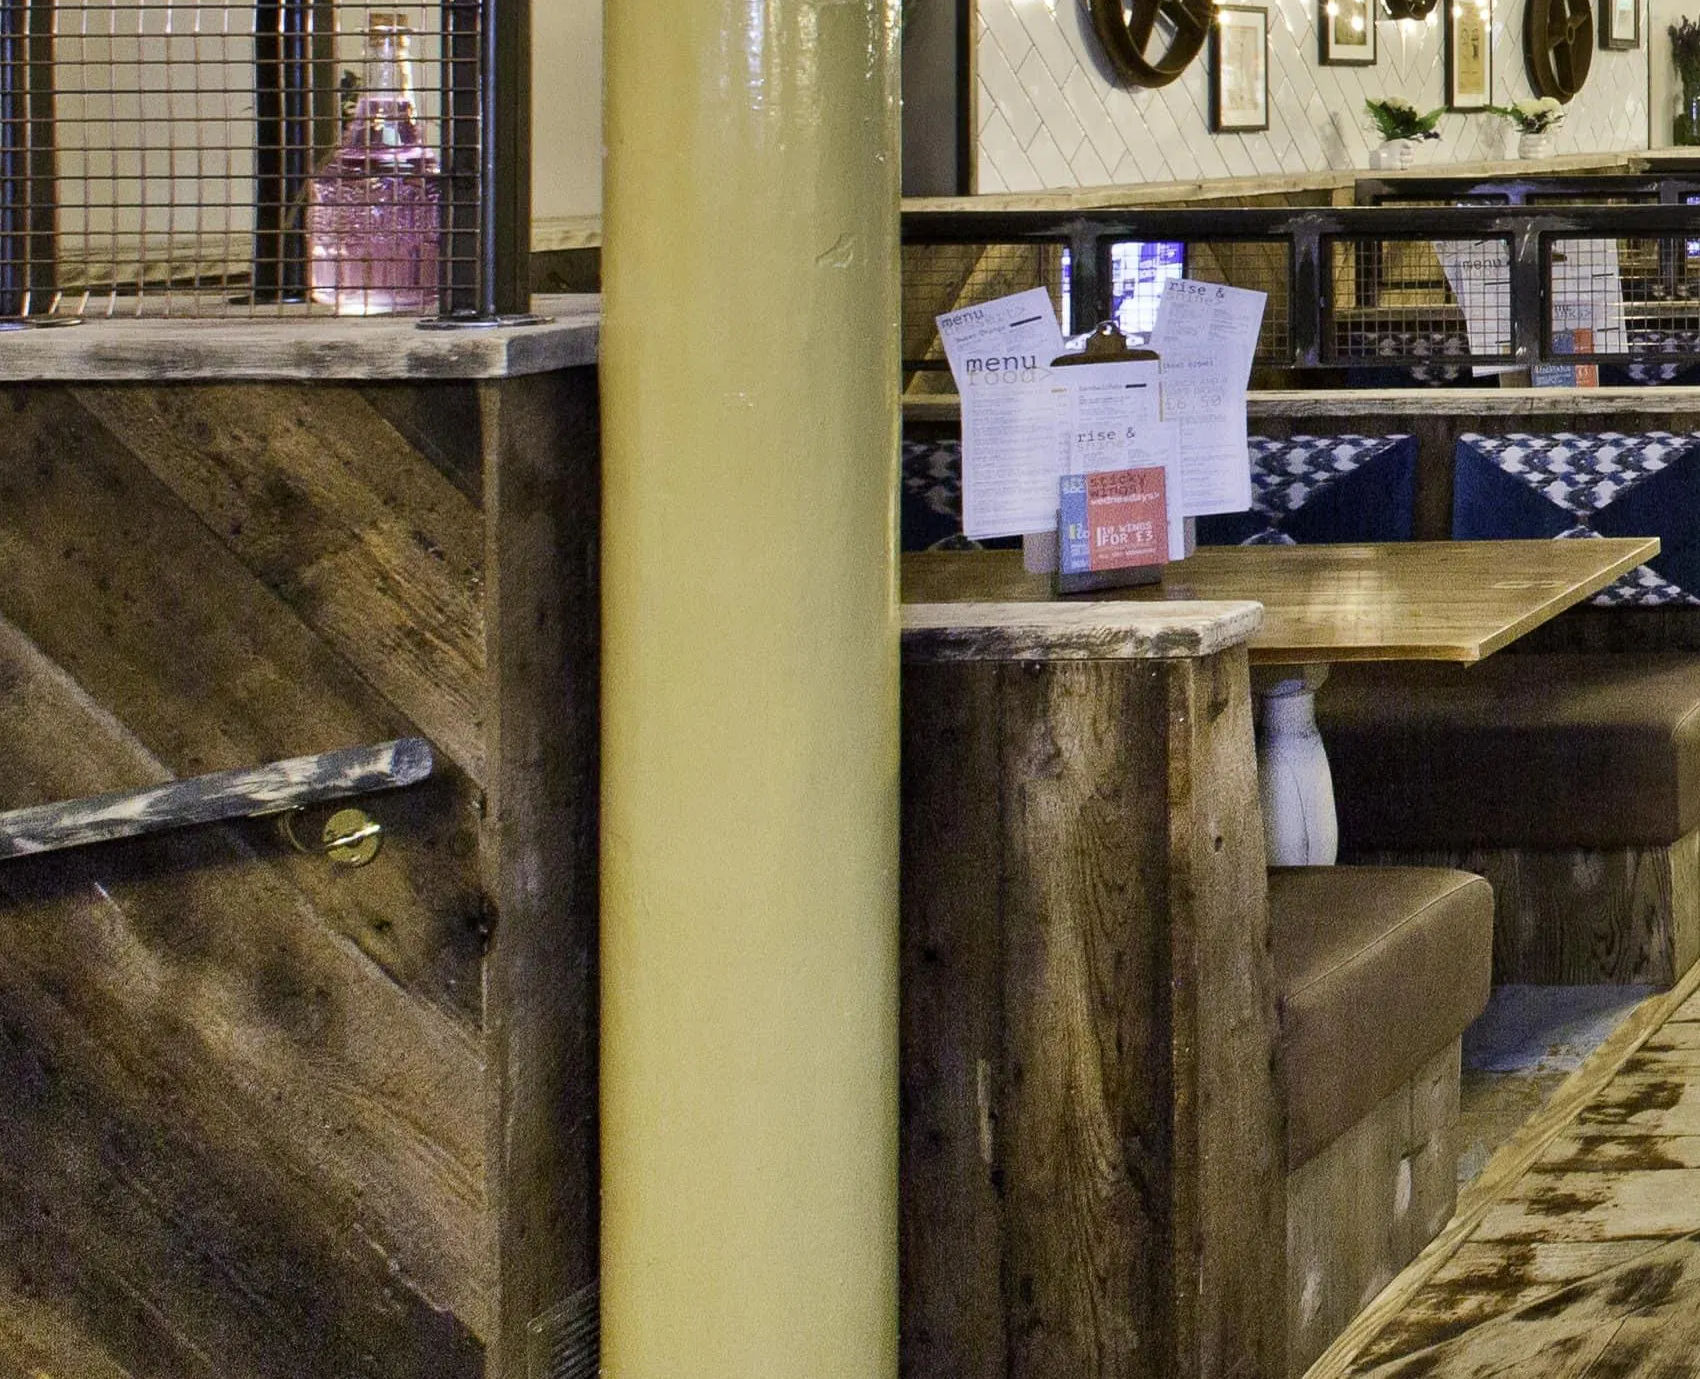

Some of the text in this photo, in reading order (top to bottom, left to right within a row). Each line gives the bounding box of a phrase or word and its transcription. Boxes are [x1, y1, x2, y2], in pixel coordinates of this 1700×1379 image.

[1168, 281, 1207, 296] rise
[941, 309, 985, 329] menu
[965, 354, 1038, 373] menu
[1078, 425, 1136, 443] rise &
[1103, 532, 1129, 545] FOR
